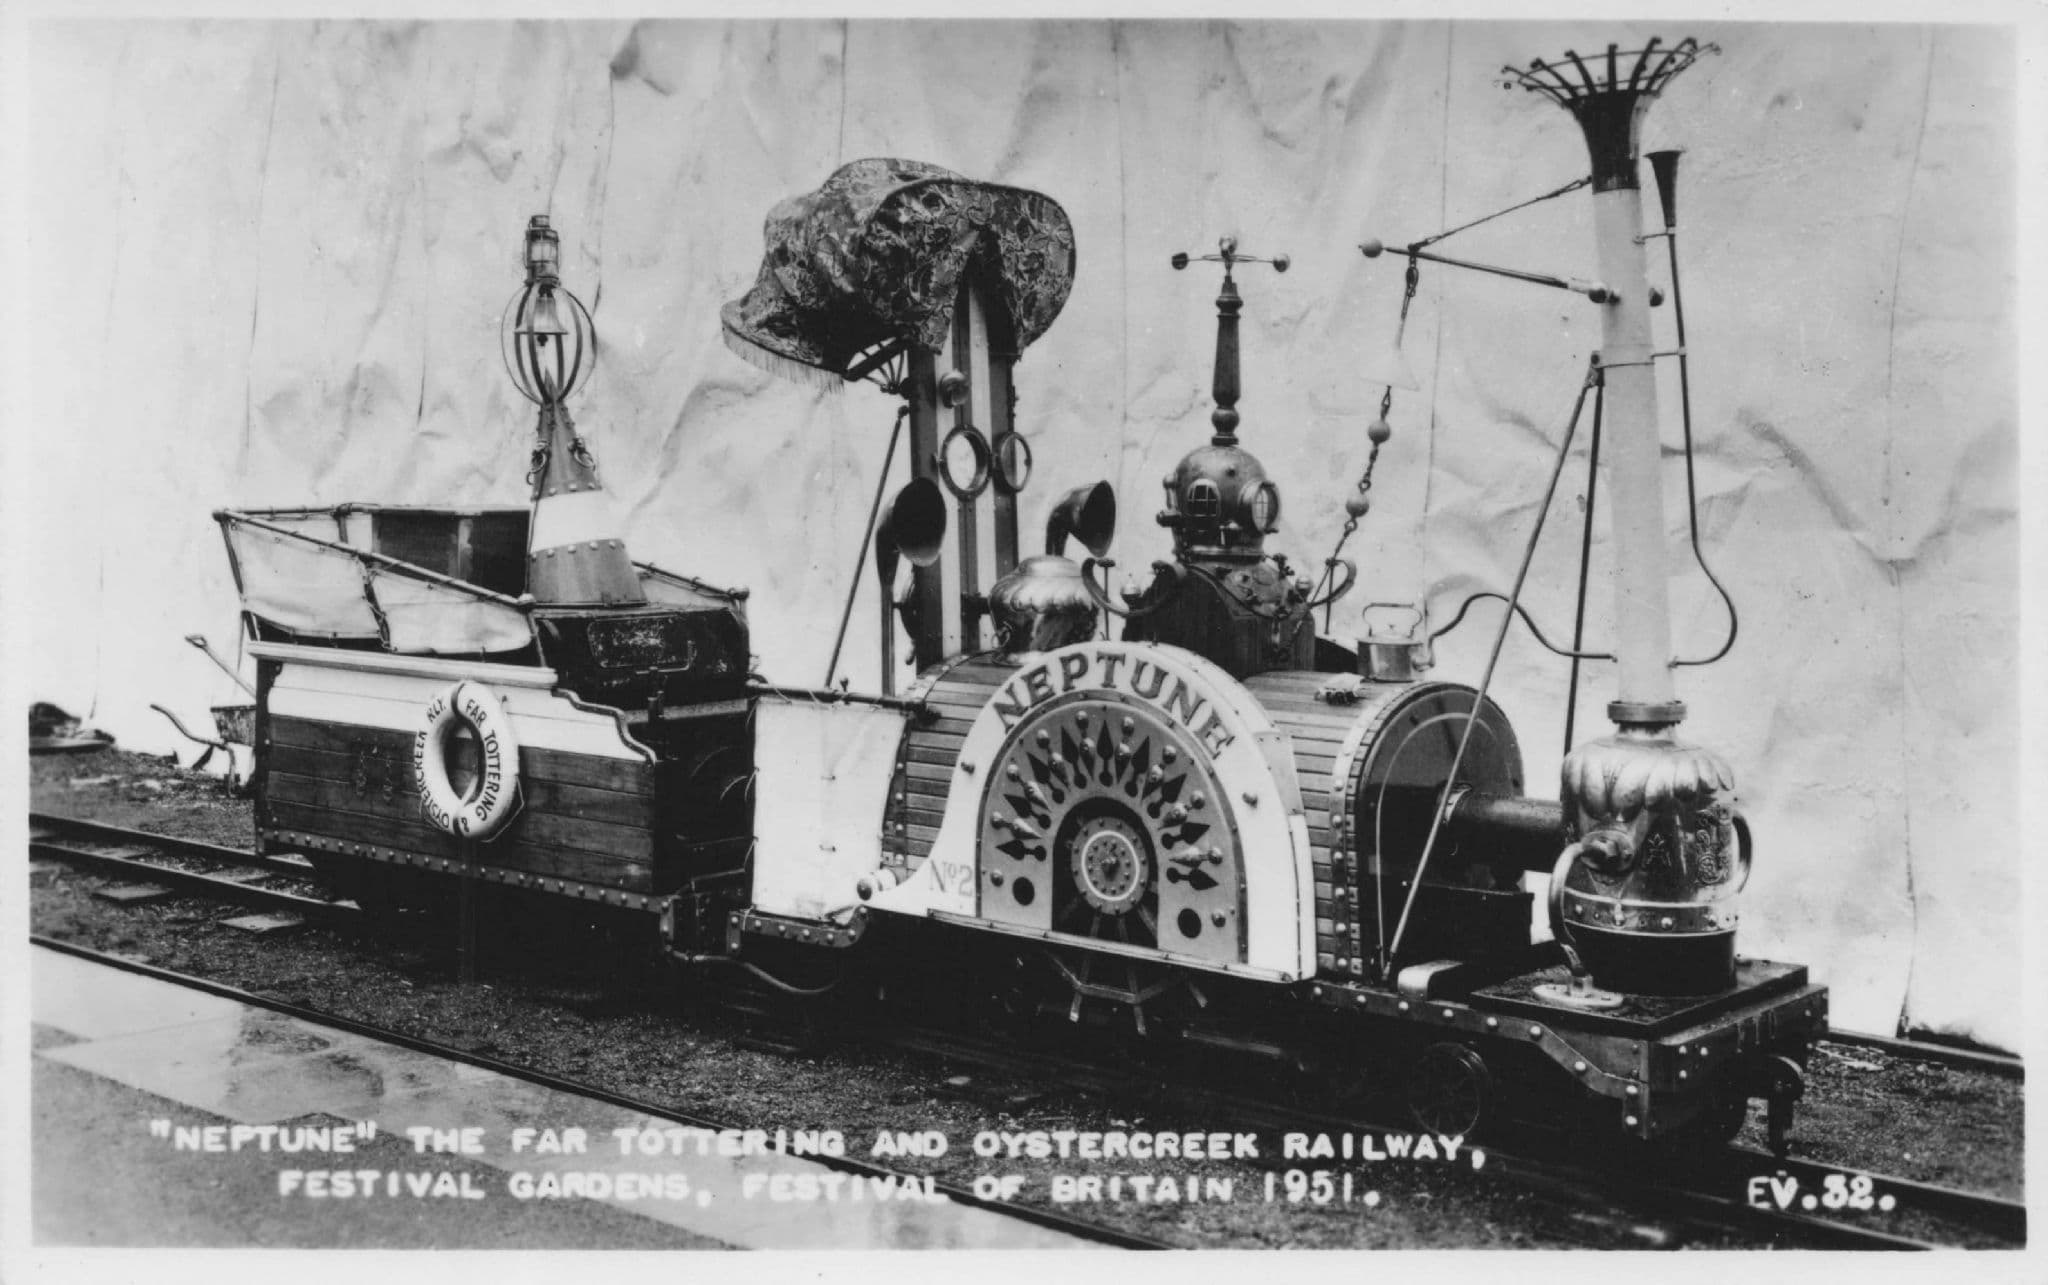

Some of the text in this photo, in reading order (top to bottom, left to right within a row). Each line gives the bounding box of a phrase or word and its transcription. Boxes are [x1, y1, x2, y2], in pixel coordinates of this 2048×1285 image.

[465, 698, 487, 729] FAR
[993, 651, 1236, 760] NEPTUNE
[474, 728, 501, 821] TOTTERING
